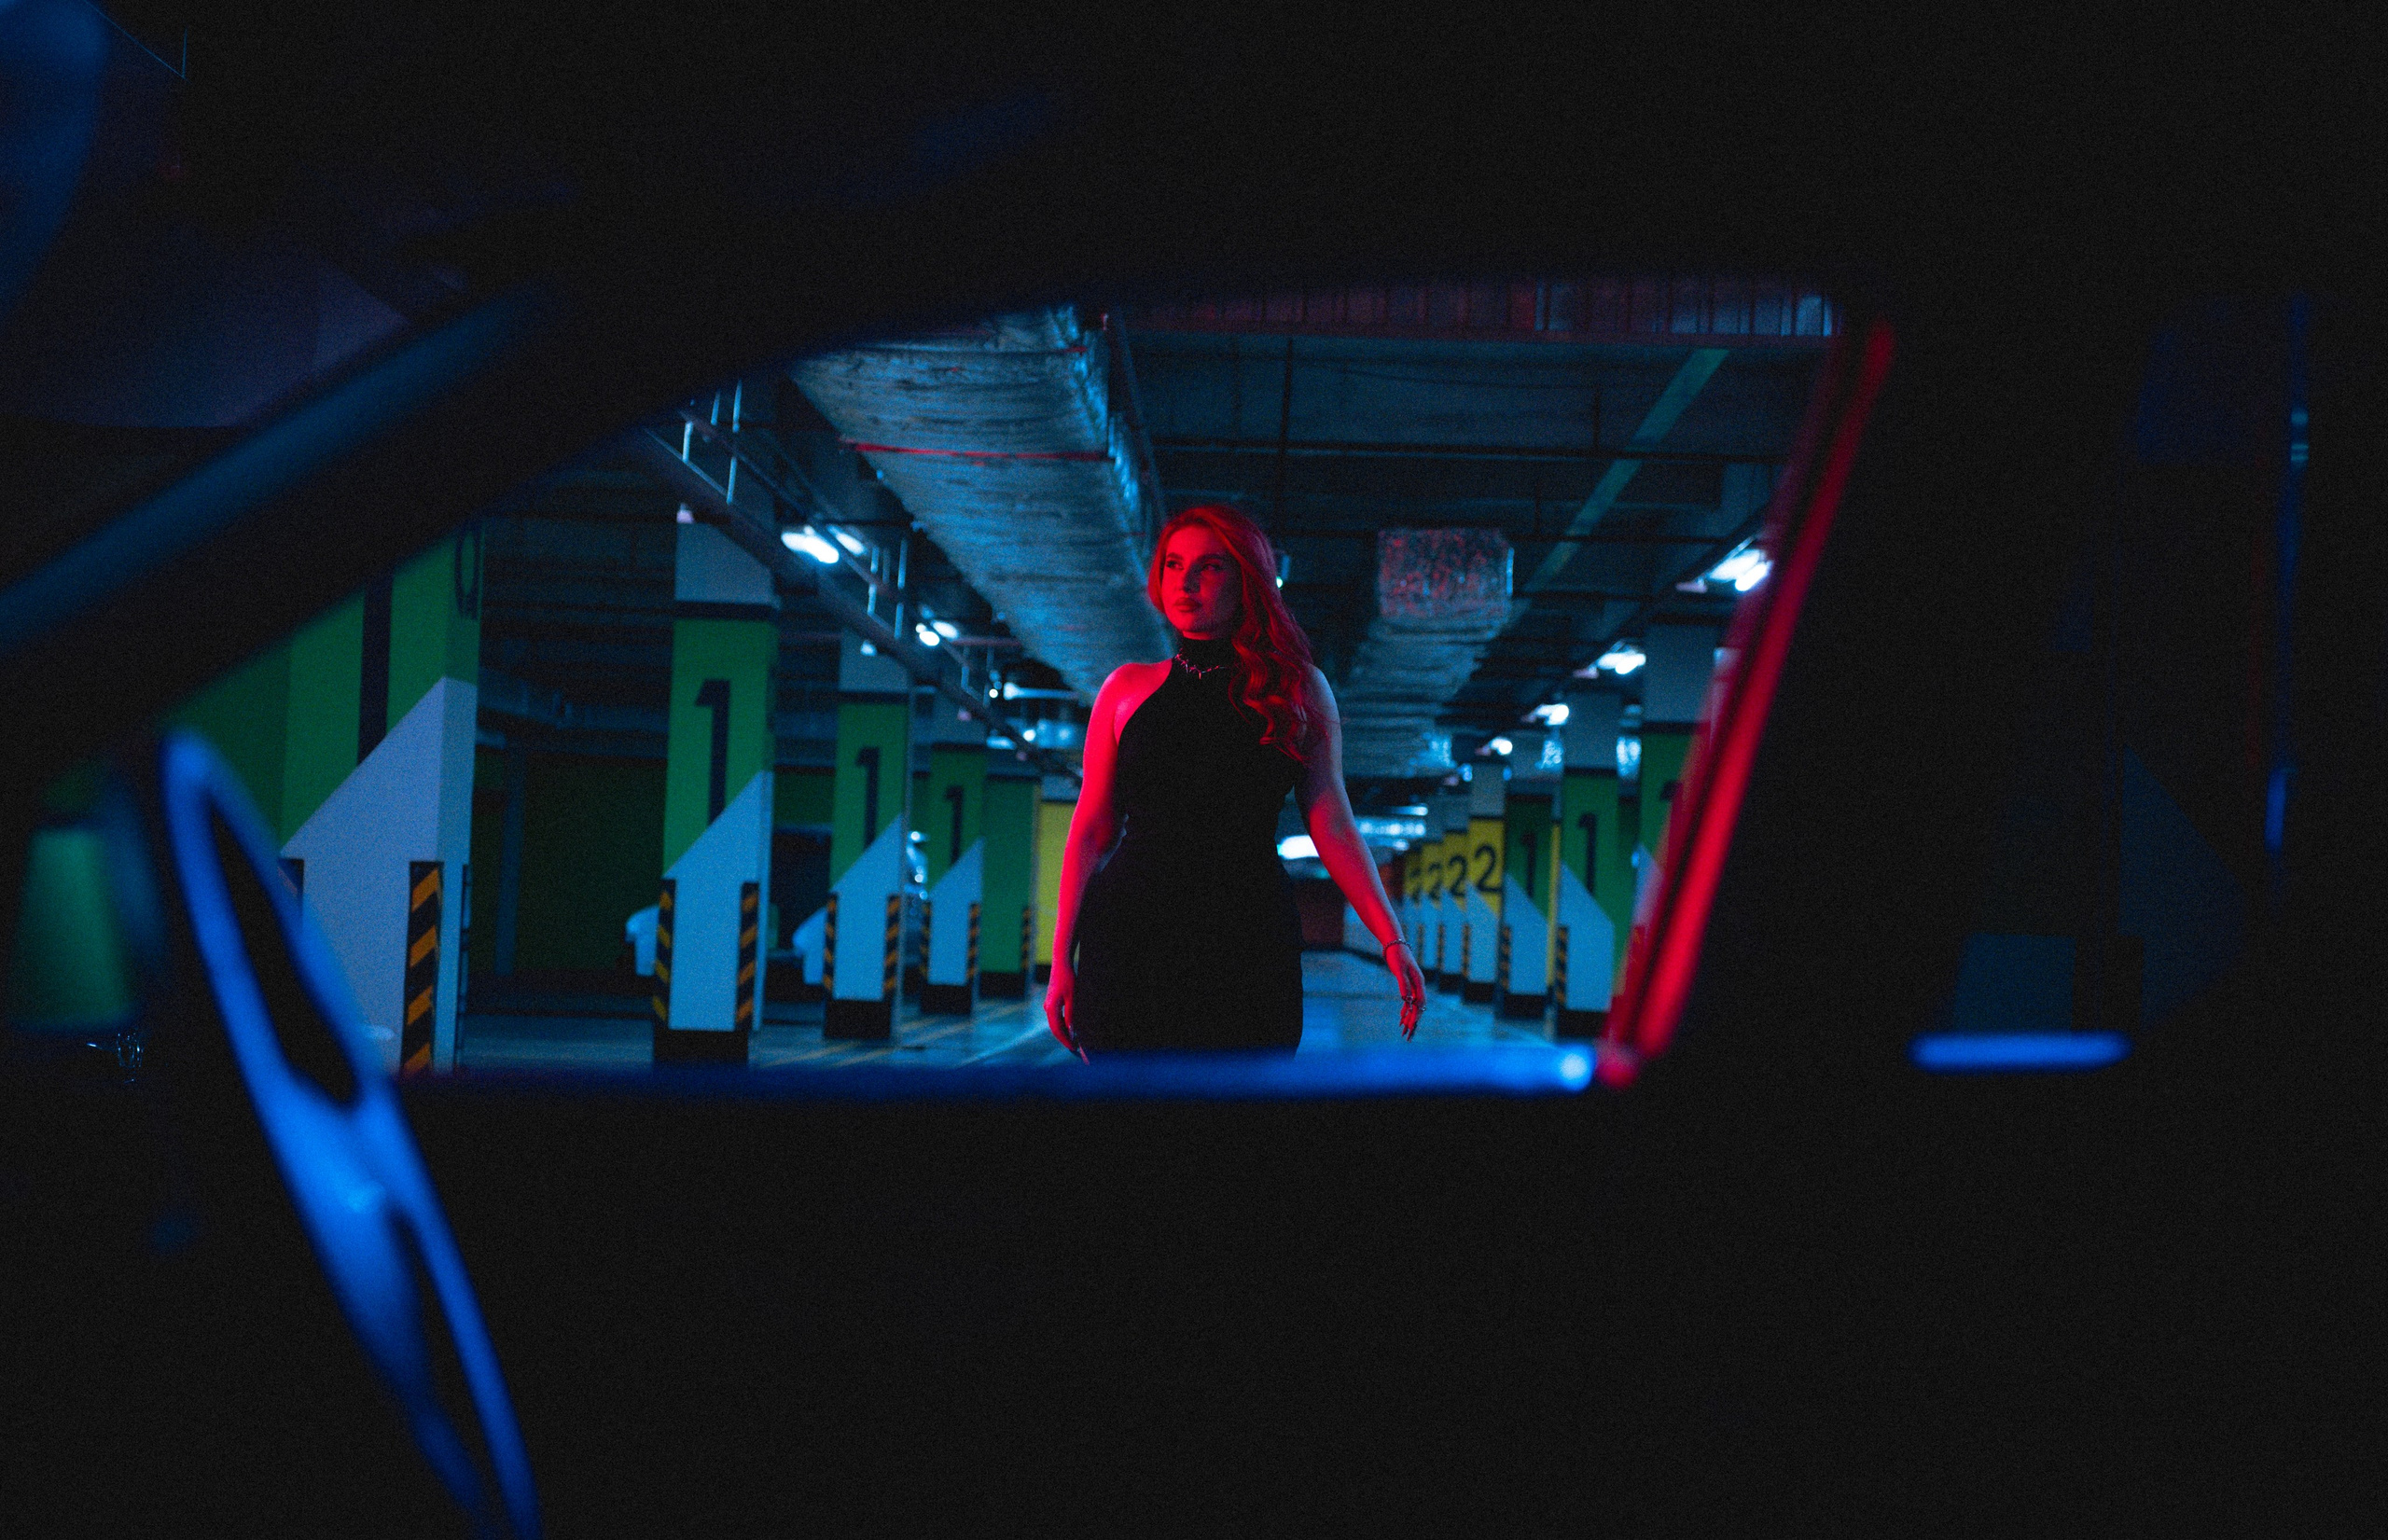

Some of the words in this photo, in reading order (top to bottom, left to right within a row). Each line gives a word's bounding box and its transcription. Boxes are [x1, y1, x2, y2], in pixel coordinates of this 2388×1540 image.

[697, 679, 730, 825] 1
[855, 748, 880, 848] 1
[945, 785, 965, 865] 1
[1449, 853, 1467, 897] 2
[1475, 844, 1503, 893] 2
[1520, 832, 1537, 898] 1
[1577, 812, 1597, 896] 1
